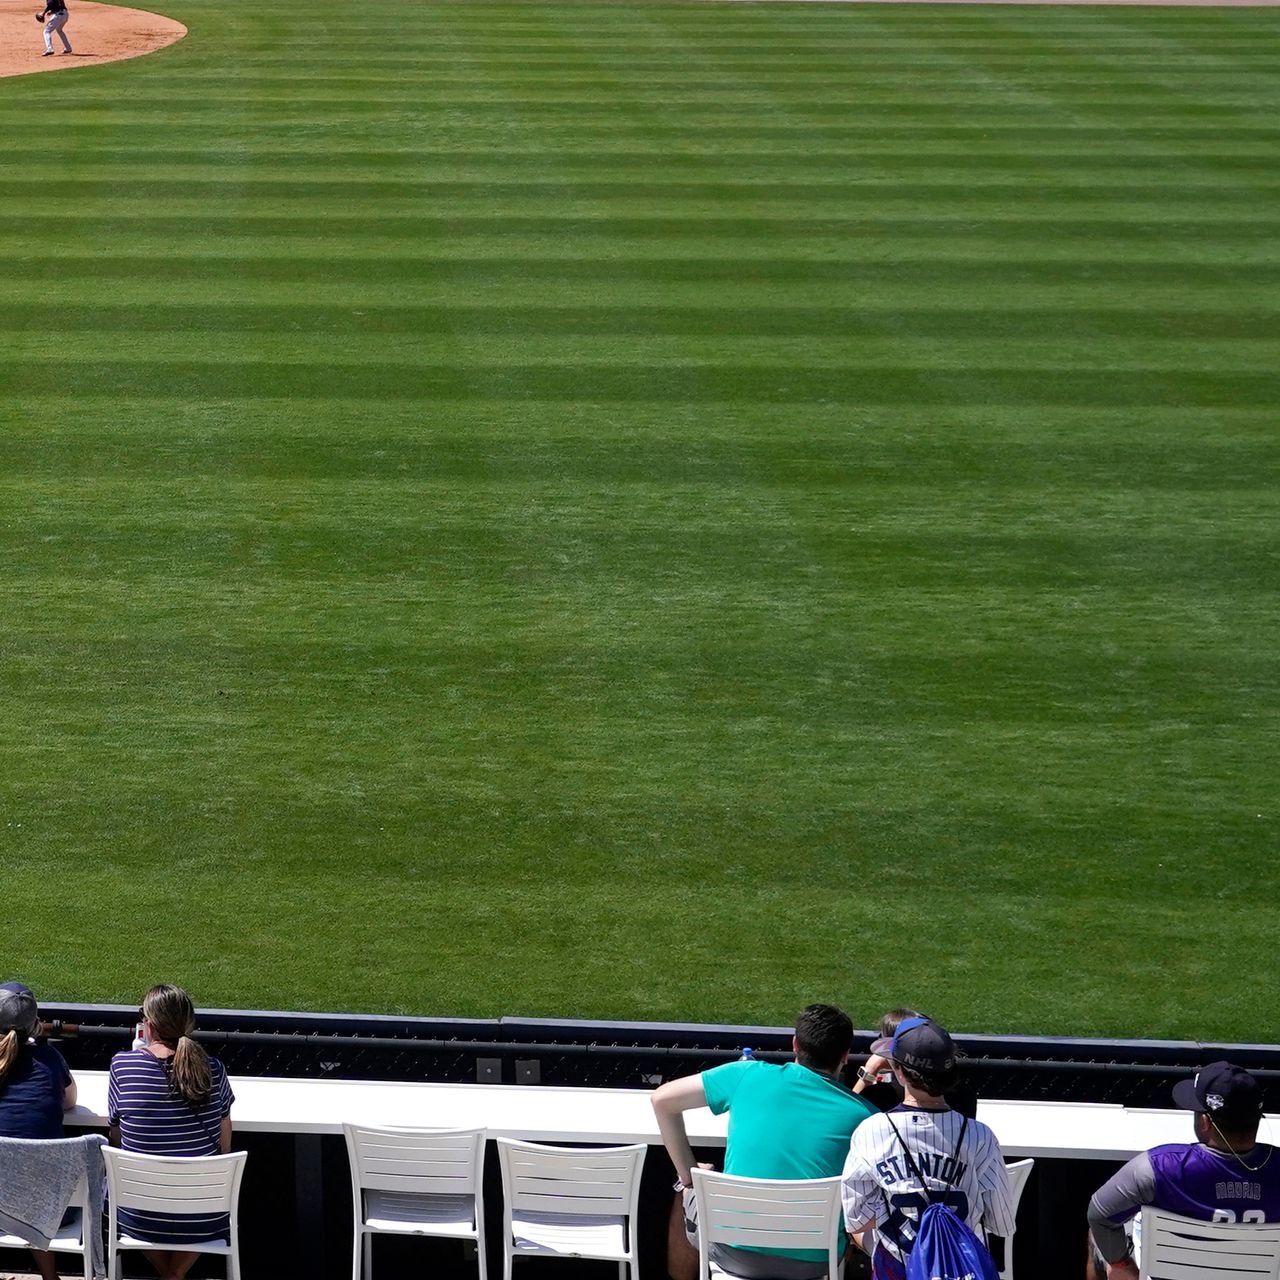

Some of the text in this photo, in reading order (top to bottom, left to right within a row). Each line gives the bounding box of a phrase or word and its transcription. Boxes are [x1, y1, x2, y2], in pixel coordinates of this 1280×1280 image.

[904, 1053, 934, 1069] NHL
[876, 1152, 968, 1188] STANTON
[1216, 1181, 1262, 1200] MADRID
